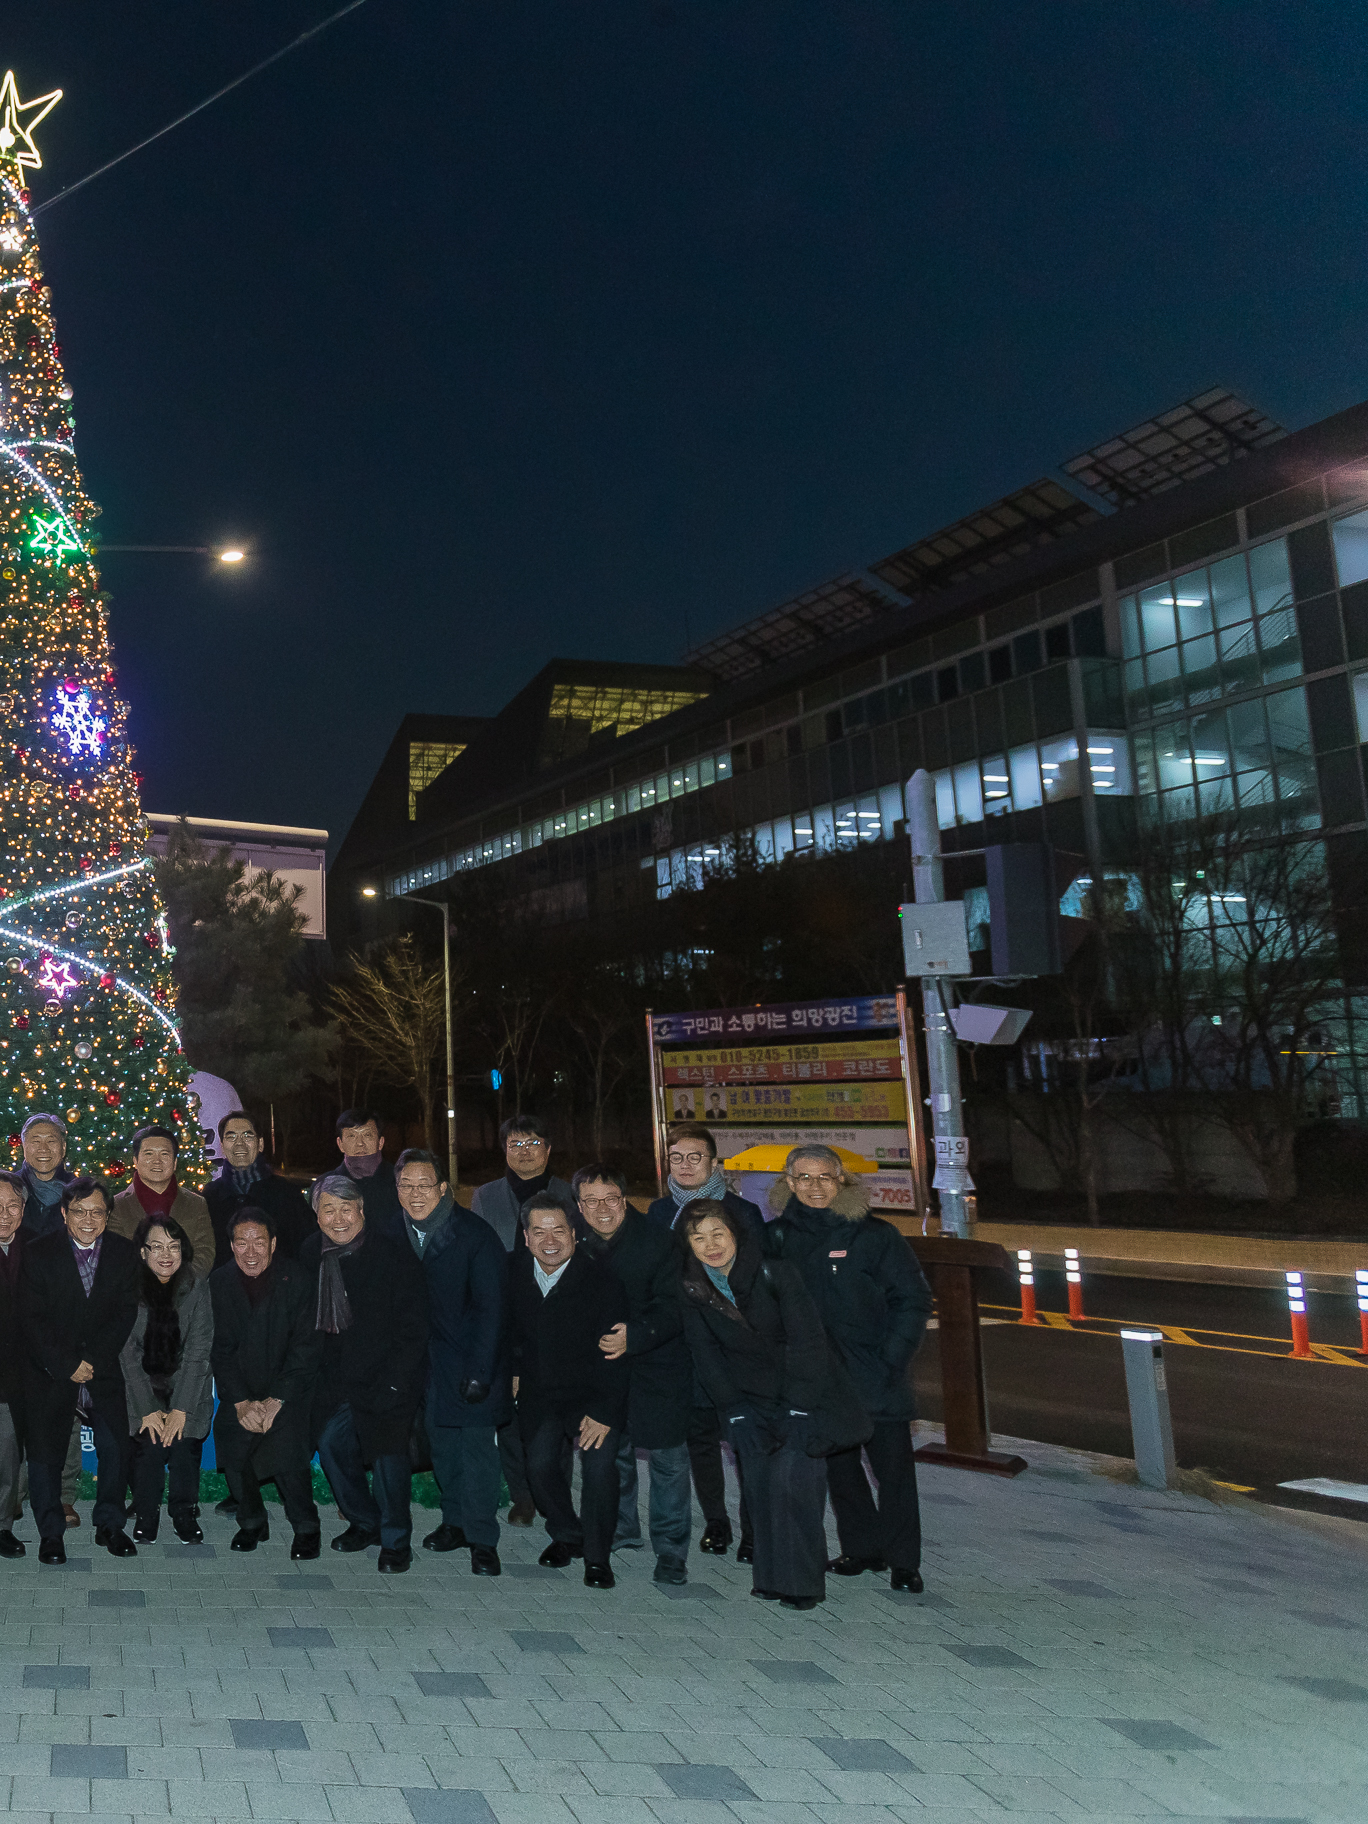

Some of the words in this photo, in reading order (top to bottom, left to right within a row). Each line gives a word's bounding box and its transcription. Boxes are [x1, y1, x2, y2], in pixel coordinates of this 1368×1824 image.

[682, 1015, 724, 1036] 구민과
[727, 1011, 788, 1032] 소통하는
[791, 1005, 858, 1027] 희망광진
[677, 1066, 715, 1081] 렉스턴
[728, 1064, 769, 1078] 스포츠
[842, 1060, 891, 1076] 코란도
